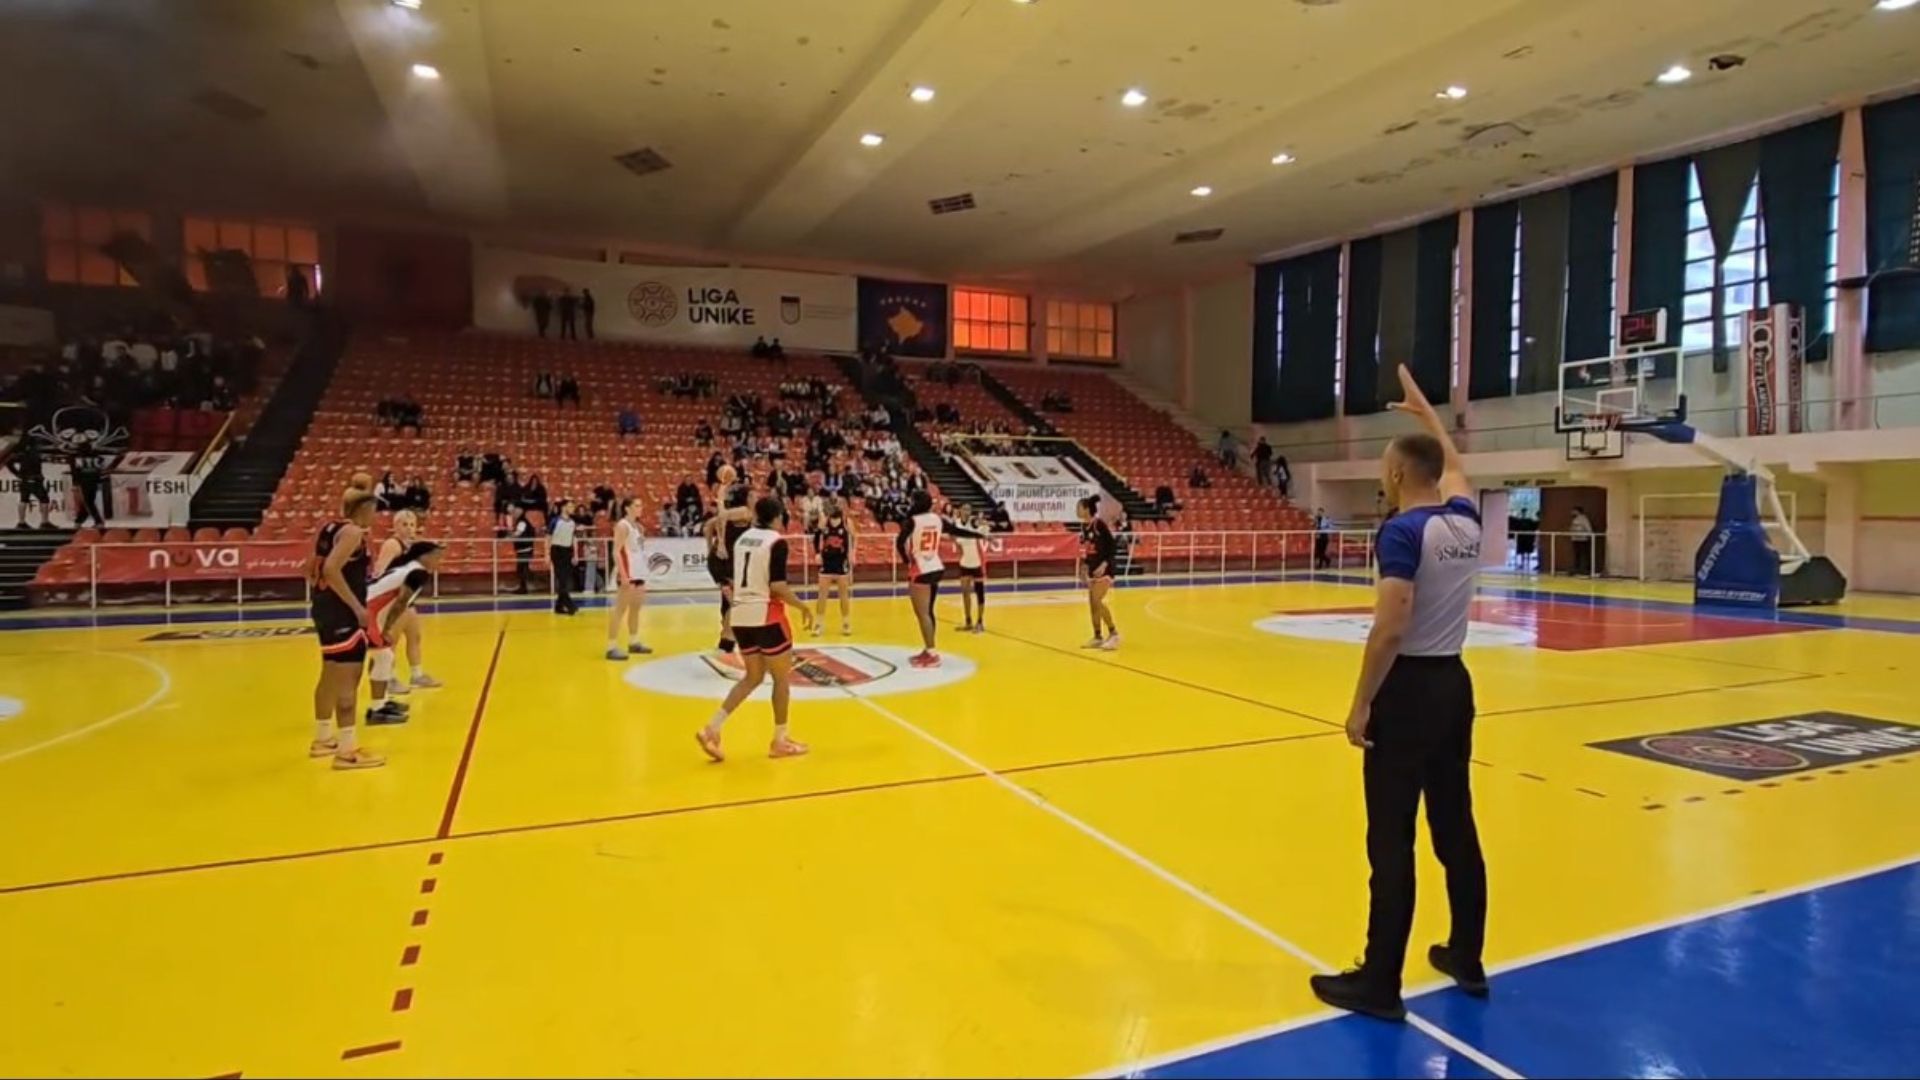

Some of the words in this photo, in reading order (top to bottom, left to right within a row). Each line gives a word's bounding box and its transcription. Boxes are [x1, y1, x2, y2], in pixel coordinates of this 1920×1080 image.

[688, 287, 740, 304] LIGA
[689, 307, 756, 325] UNIKE
[921, 531, 938, 551] 21
[149, 549, 240, 569] nova
[742, 551, 753, 588] 1
